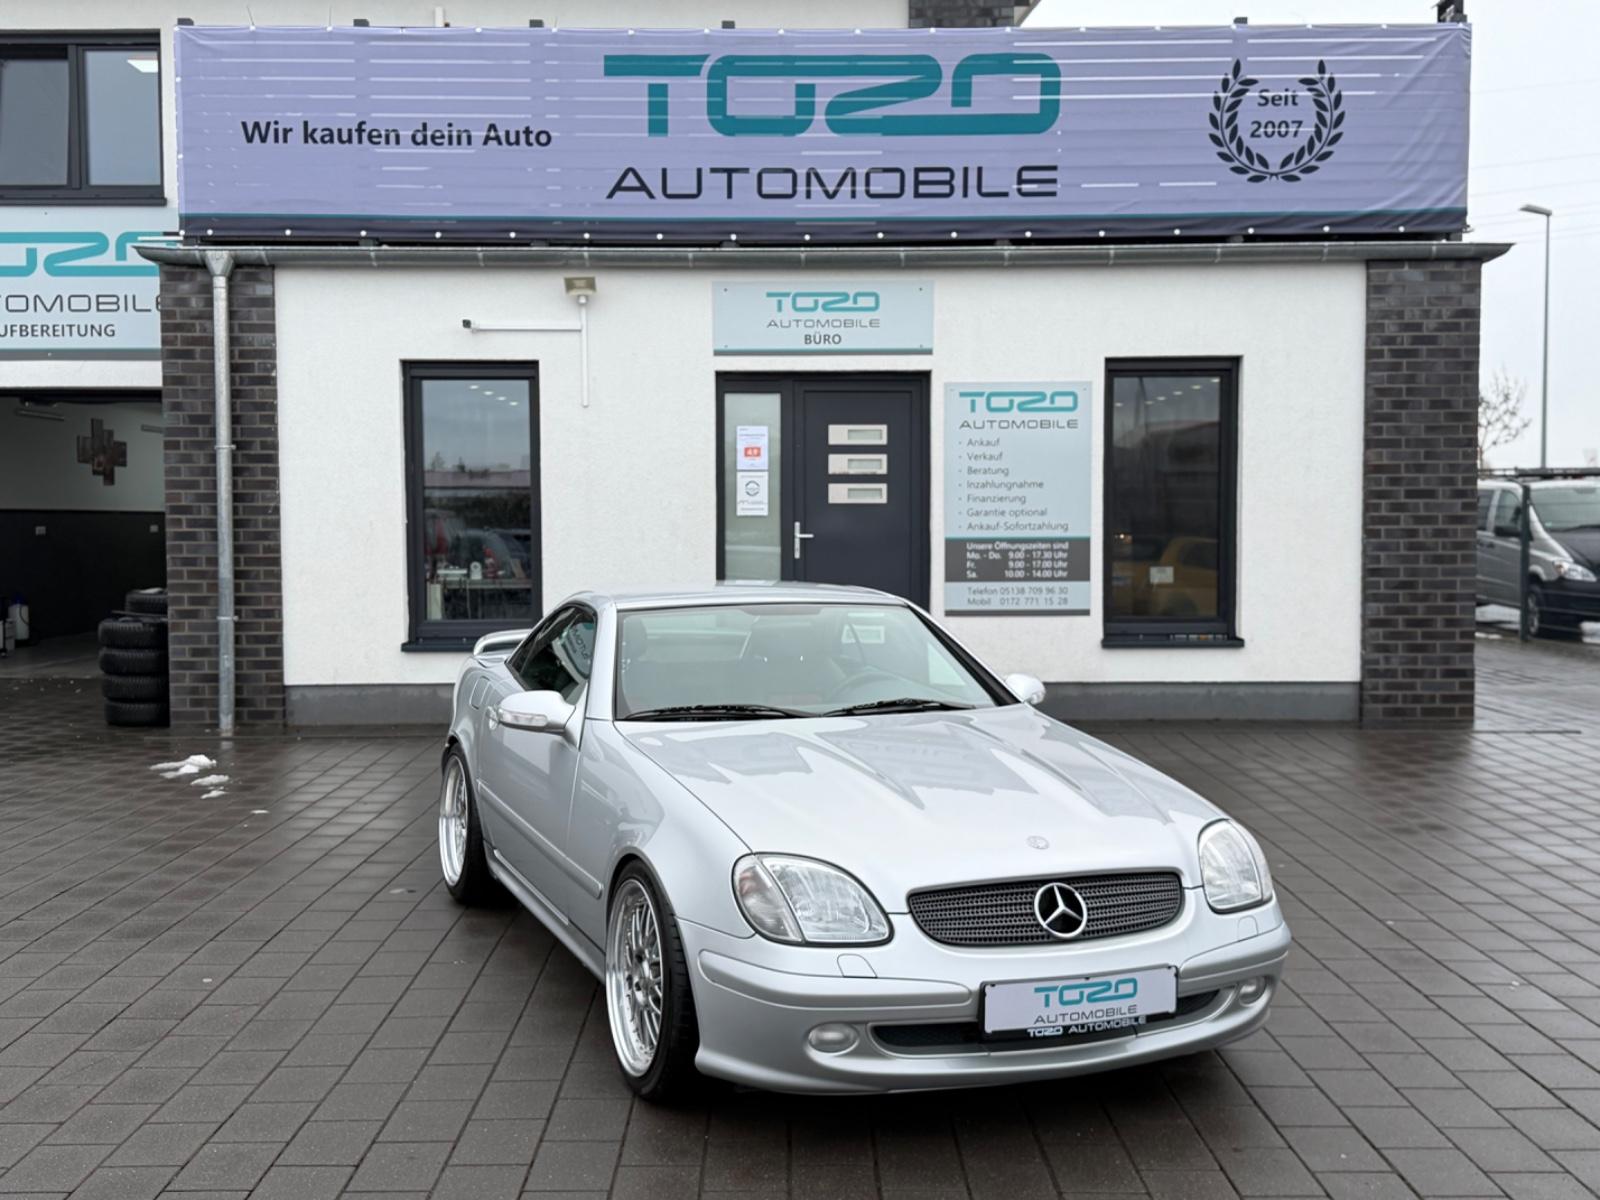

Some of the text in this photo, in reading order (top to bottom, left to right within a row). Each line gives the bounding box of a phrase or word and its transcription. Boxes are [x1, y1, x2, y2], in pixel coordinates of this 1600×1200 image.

[603, 52, 1061, 137] TOZO
[1250, 88, 1303, 138] Seit 2007
[241, 120, 552, 147] Wir kaufen dein Auto
[605, 165, 1058, 200] AUTOMOBILE
[0, 294, 161, 313] OMOBIL
[766, 291, 880, 312] TOZO
[766, 319, 880, 328] AUTOMOBILE
[804, 332, 842, 345] BÜRO
[959, 391, 1078, 413] TOZO
[959, 419, 1079, 429] AUTOMOBILE
[967, 438, 1000, 447] Ankauf
[967, 452, 1003, 461] Verkauf
[967, 466, 1009, 477] Beratung
[967, 480, 1044, 491] Inzahlungnahme
[967, 494, 1026, 504] Finanzierung
[967, 508, 1048, 519] Garantie optional
[1052, 542, 1069, 550] sind
[1053, 551, 1068, 559] Uhr
[1053, 570, 1068, 578] Uhr
[967, 587, 997, 595] Telefon
[967, 598, 991, 606] Mobil
[1000, 598, 1020, 606] 0172
[1034, 977, 1138, 1008] TOZO
[1034, 1004, 1137, 1024] AUTOMOBILE
[1027, 1016, 1146, 1037] TOZO AUTOMOBILE
